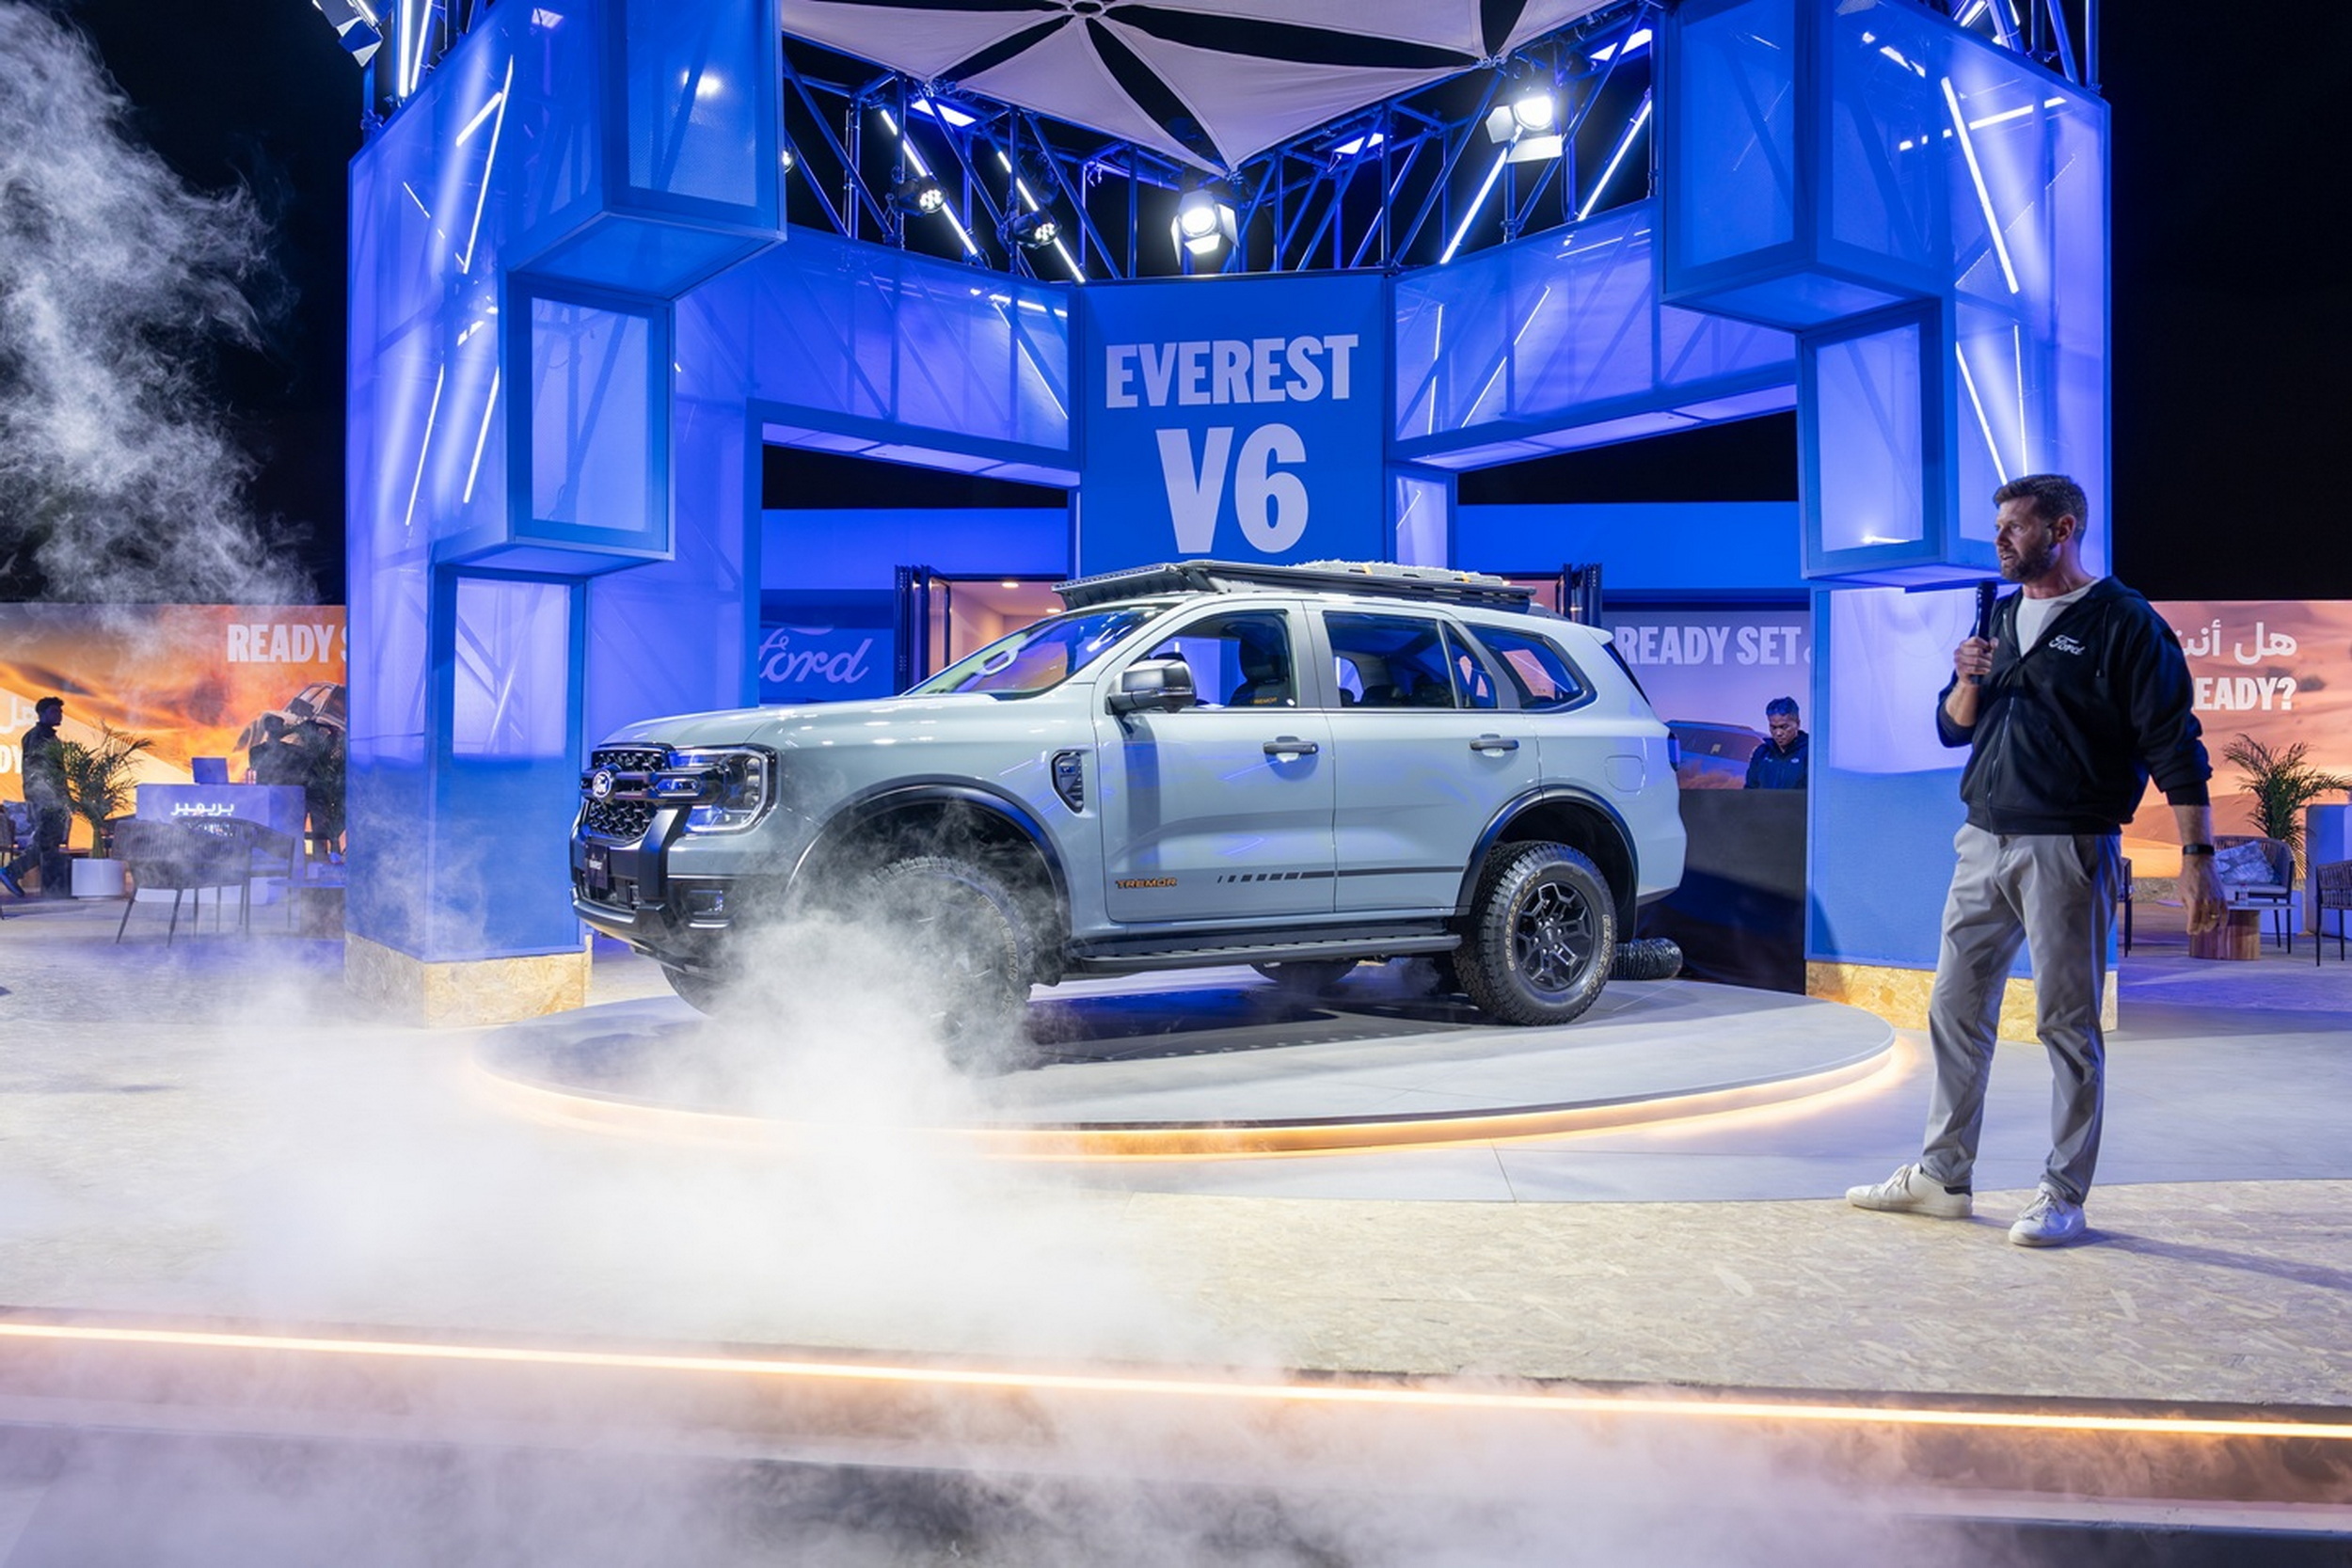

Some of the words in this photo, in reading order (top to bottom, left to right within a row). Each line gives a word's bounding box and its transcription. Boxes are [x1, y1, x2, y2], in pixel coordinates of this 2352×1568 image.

[1106, 334, 1359, 408] EVEREST
[1155, 423, 1309, 553] V6
[228, 625, 336, 663] READY
[1614, 626, 1730, 665] READY
[1736, 626, 1802, 665] SET
[2048, 634, 2086, 656] Ford
[2234, 622, 2297, 665] هل
[2191, 676, 2297, 710] EADY?
[1115, 877, 1178, 889] TREMOR
